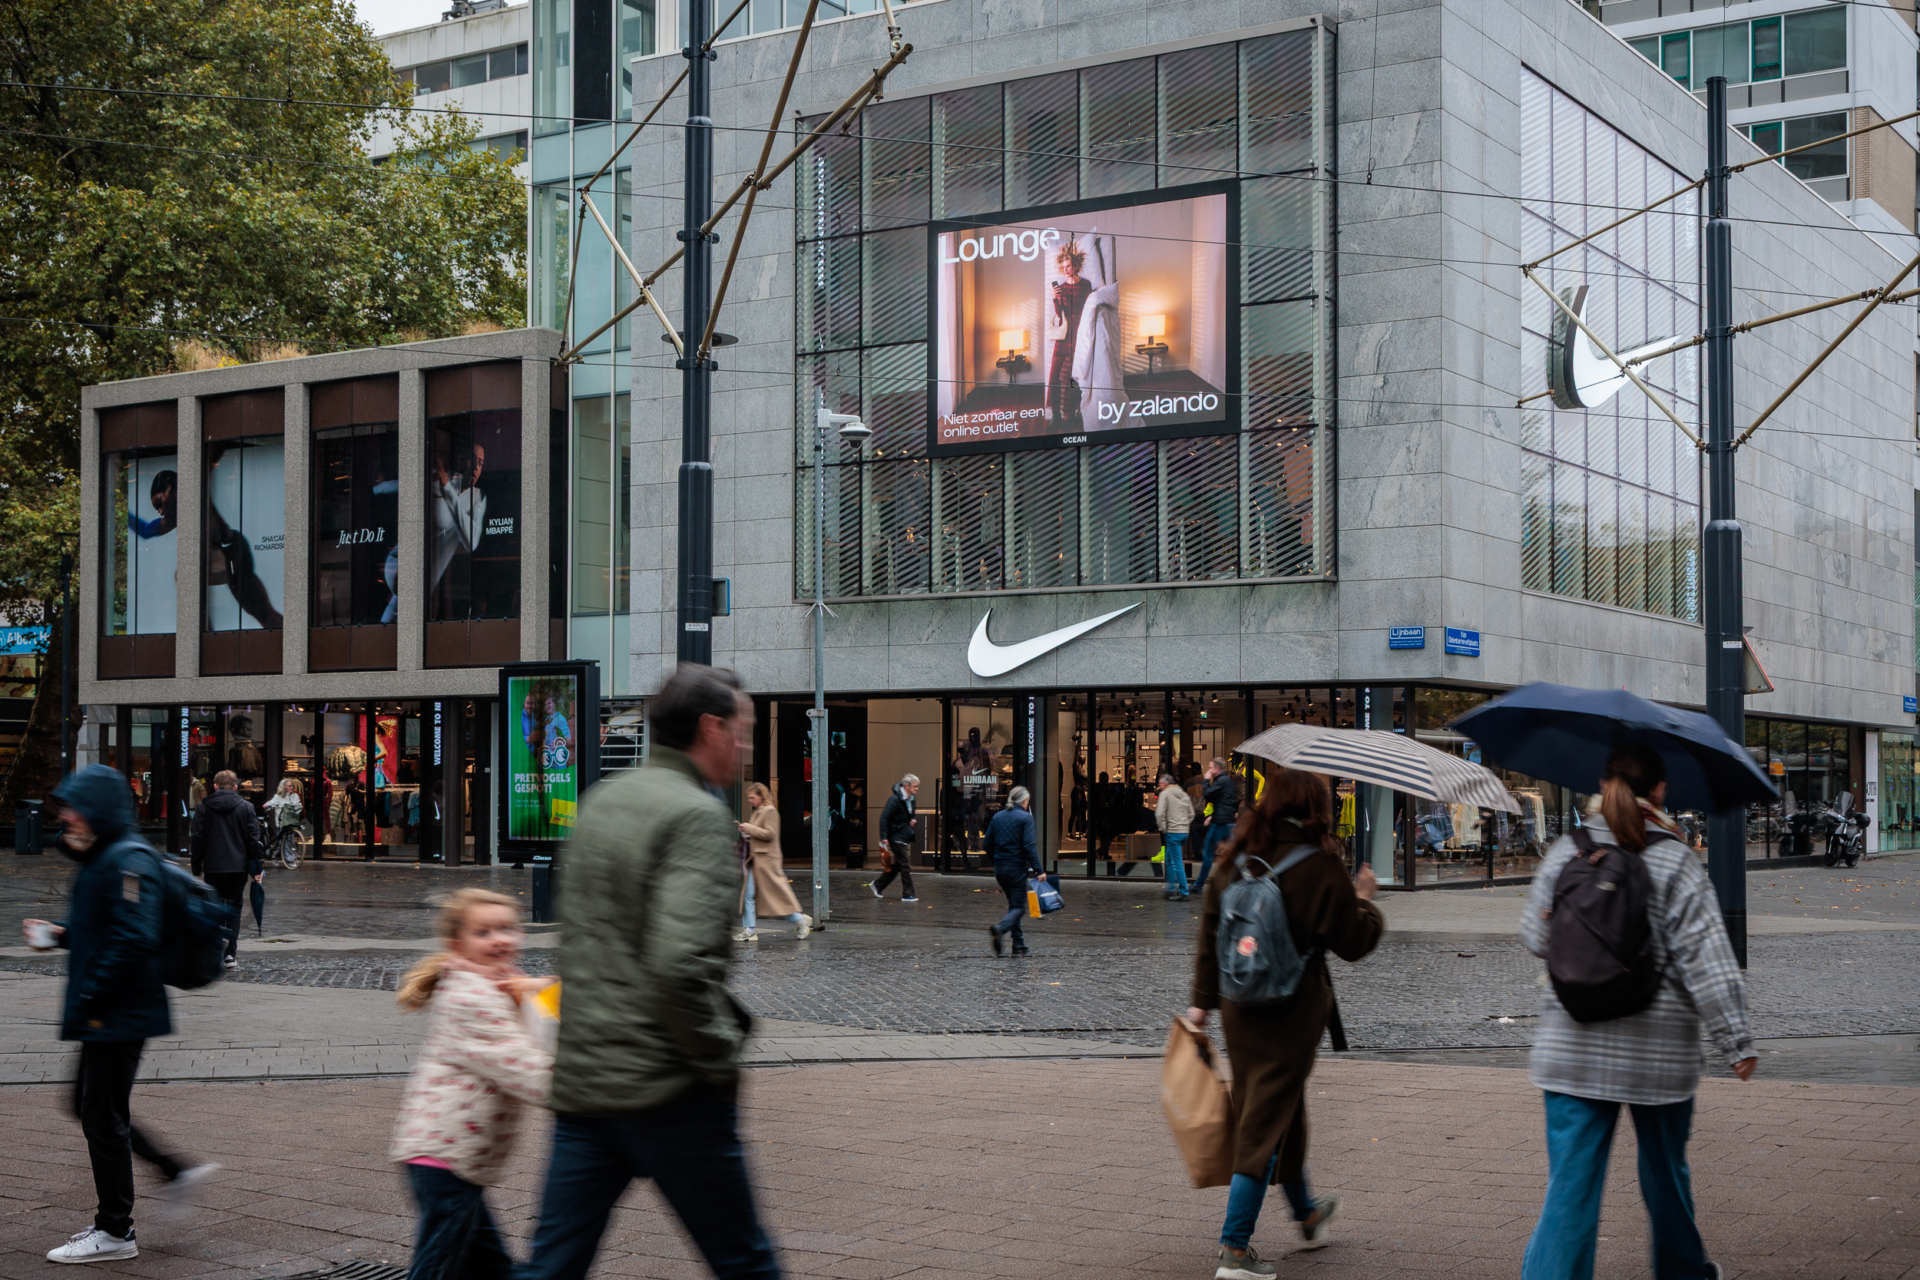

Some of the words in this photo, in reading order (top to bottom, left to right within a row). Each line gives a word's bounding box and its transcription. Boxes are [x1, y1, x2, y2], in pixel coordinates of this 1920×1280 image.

[941, 227, 1060, 265] Lounge
[1098, 400, 1126, 424] by
[1129, 391, 1219, 417] zalando
[944, 412, 969, 425] Niet
[971, 409, 1018, 424] zomaar
[1020, 407, 1045, 419] een
[943, 425, 980, 438] online
[982, 421, 1019, 435] outlet
[1063, 435, 1087, 444] OCEAN
[489, 517, 513, 527] KYLIAN
[335, 529, 359, 548] Just
[358, 528, 375, 543] Do
[375, 526, 385, 542] It
[486, 525, 514, 535] MBAPPÉ
[6, 631, 38, 646] Albet
[1391, 628, 1421, 638] Lijnbaan
[1028, 702, 1035, 716] TO
[1364, 695, 1371, 710] TO
[181, 718, 190, 729] TO
[433, 713, 442, 725] TO
[181, 730, 190, 767] WELCOME
[433, 726, 442, 766] WELCOME
[514, 772, 571, 783] PRETVOGELS
[963, 775, 997, 784] LIJNBAAN
[514, 783, 552, 793] GESPOT!
